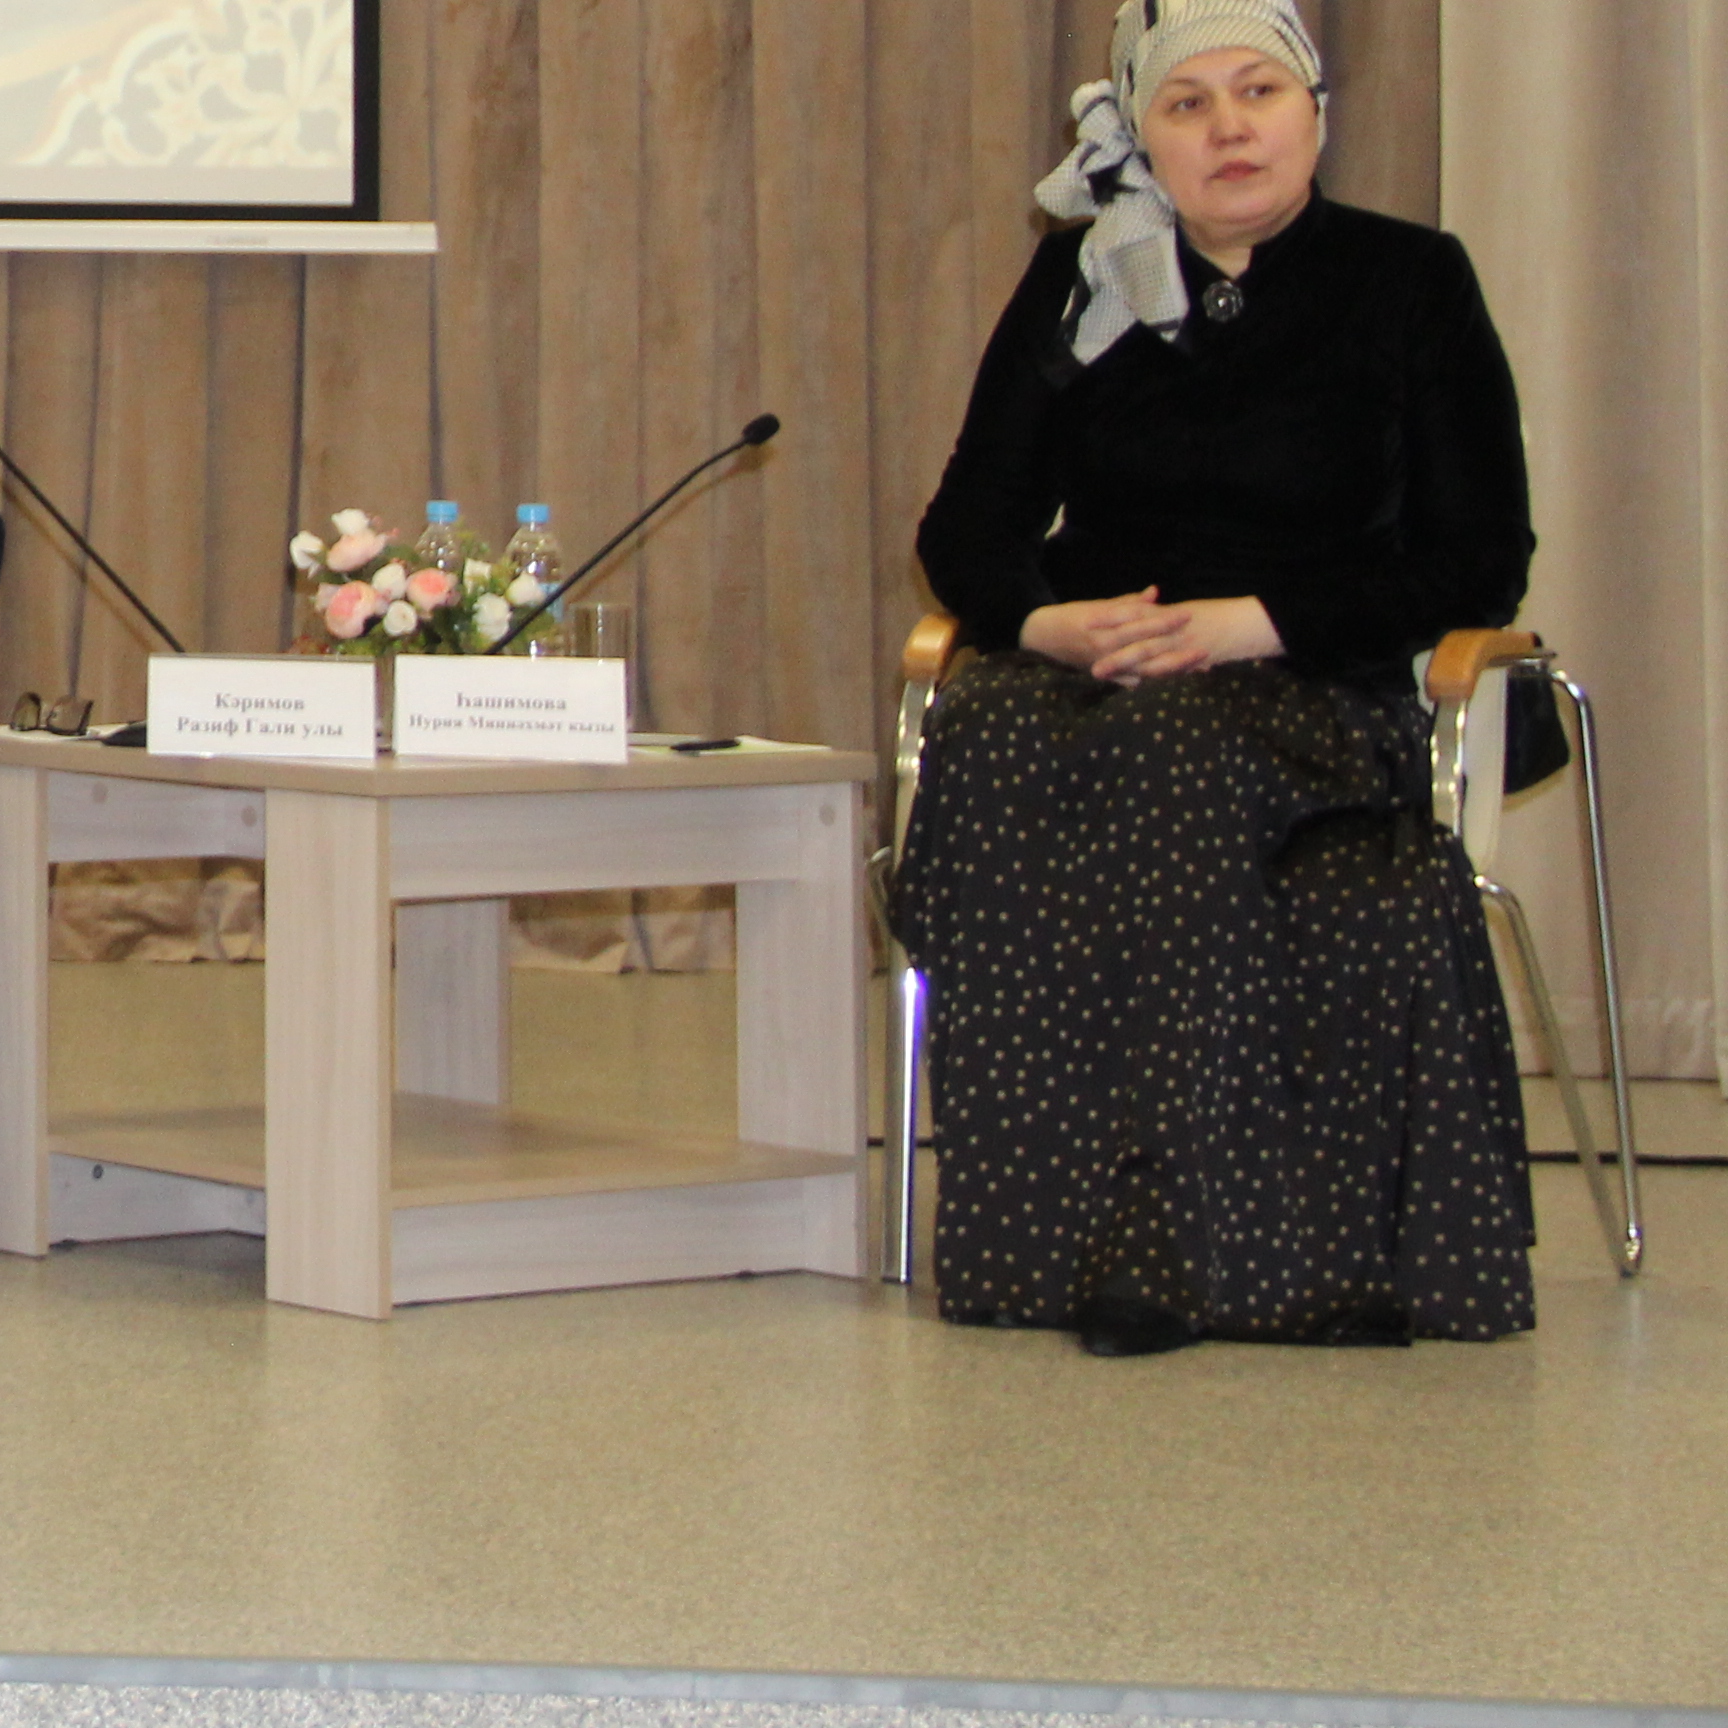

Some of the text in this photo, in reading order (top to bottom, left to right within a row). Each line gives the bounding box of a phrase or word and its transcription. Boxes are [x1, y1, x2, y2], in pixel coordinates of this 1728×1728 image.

[176, 716, 343, 738] Разиф Гали улы
